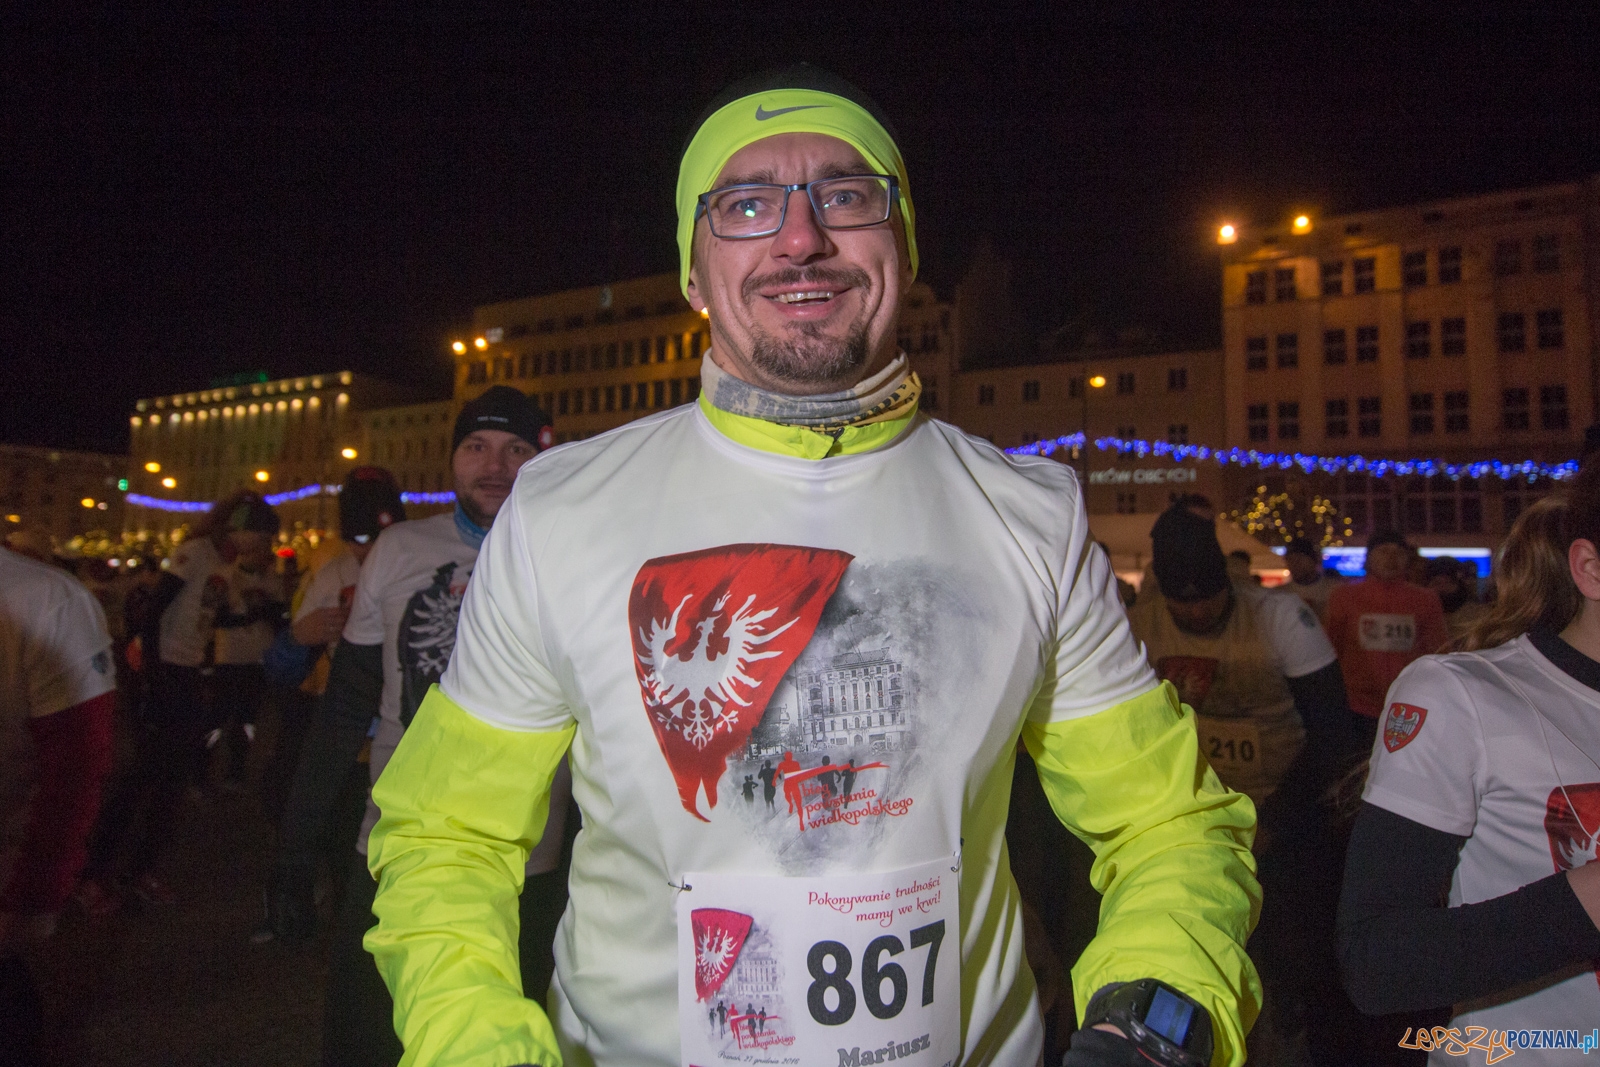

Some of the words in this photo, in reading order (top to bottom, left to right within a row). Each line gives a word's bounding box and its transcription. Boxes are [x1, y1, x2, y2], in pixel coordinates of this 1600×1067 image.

[1208, 735, 1255, 762] 210
[801, 783, 831, 799] bieg
[804, 788, 877, 819] powstania
[807, 797, 914, 829] wielkopolskiego
[808, 890, 891, 914] Pokonywanie
[895, 876, 941, 898] trudności
[856, 909, 894, 928] mamy
[898, 904, 913, 915] we
[916, 890, 942, 913] krwi!
[806, 918, 946, 1026] 867
[837, 1033, 931, 1067] Mariusz
